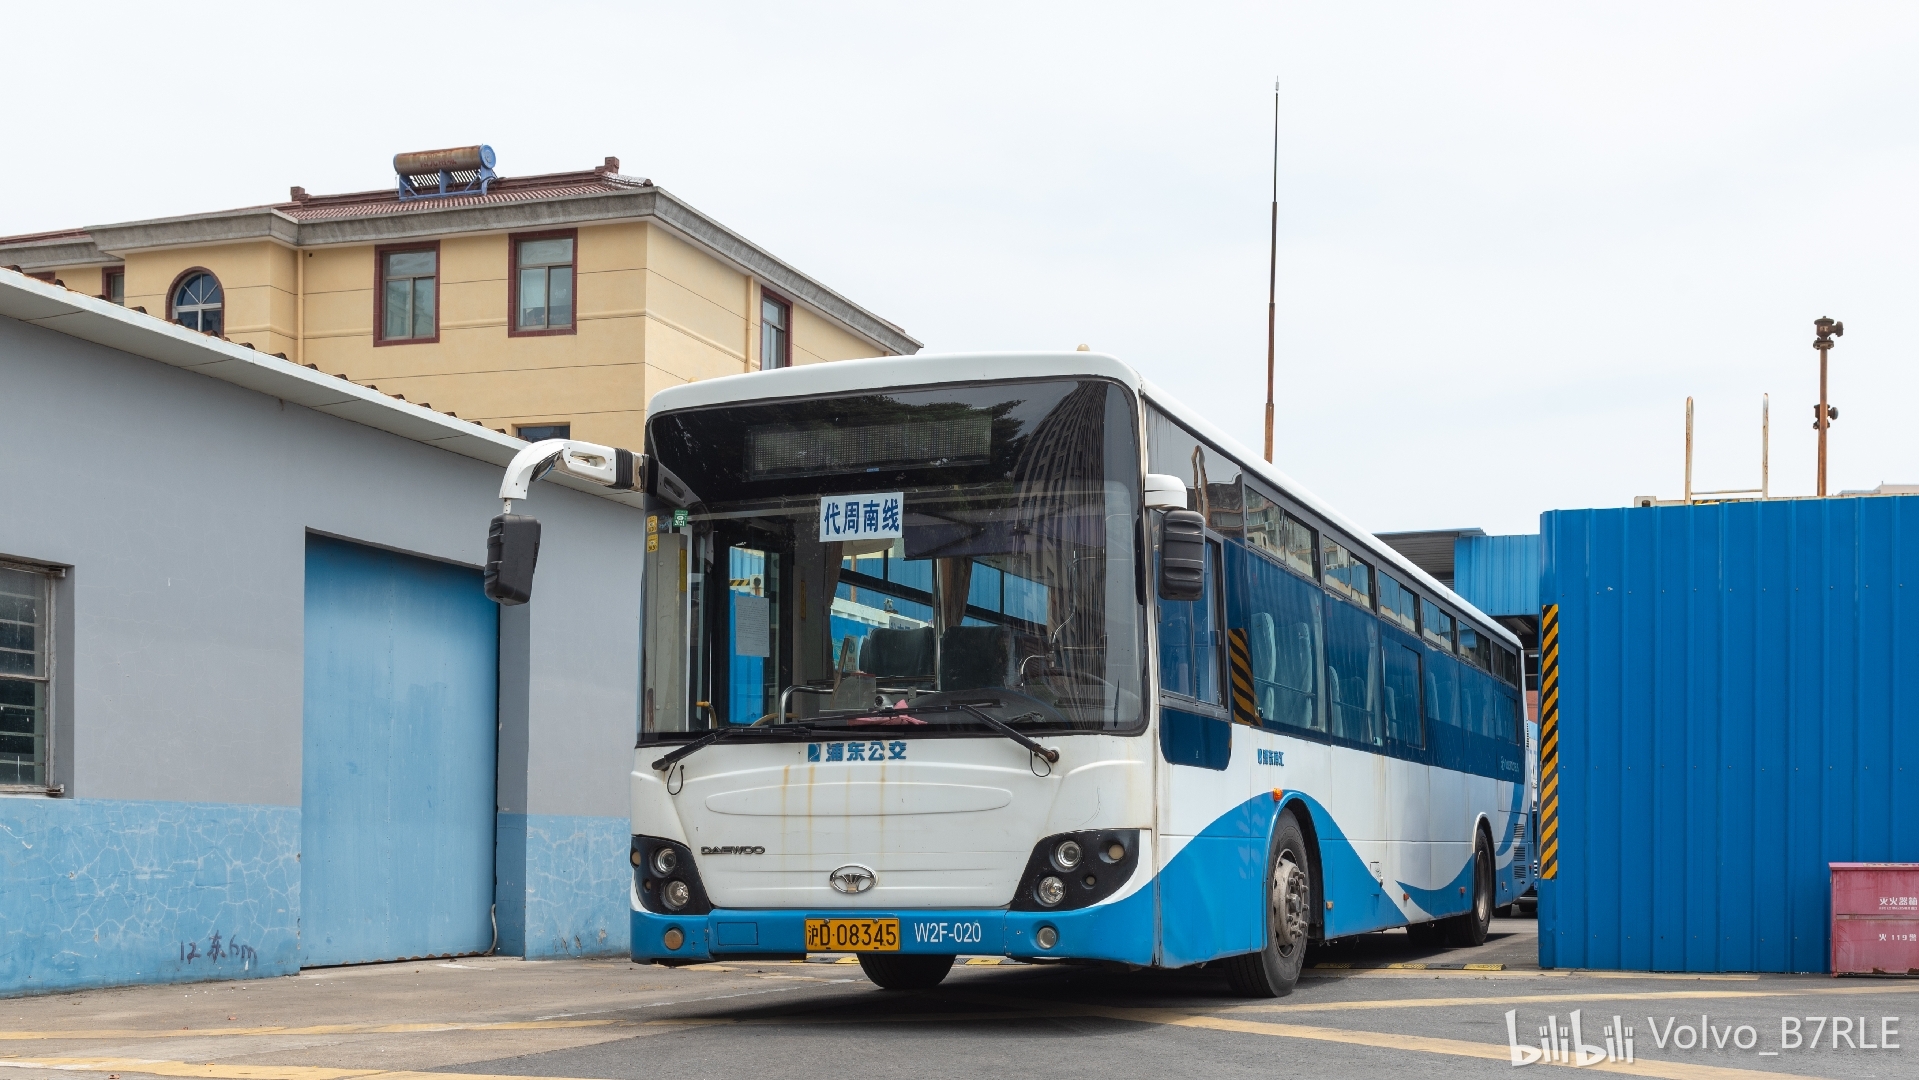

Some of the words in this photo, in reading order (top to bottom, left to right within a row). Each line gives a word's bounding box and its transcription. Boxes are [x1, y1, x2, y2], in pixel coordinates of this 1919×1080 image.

[824, 499, 900, 535] 代周南线
[826, 741, 907, 761] 浦东公交
[701, 846, 765, 855] DAEWOO
[915, 922, 982, 943] W2F-020
